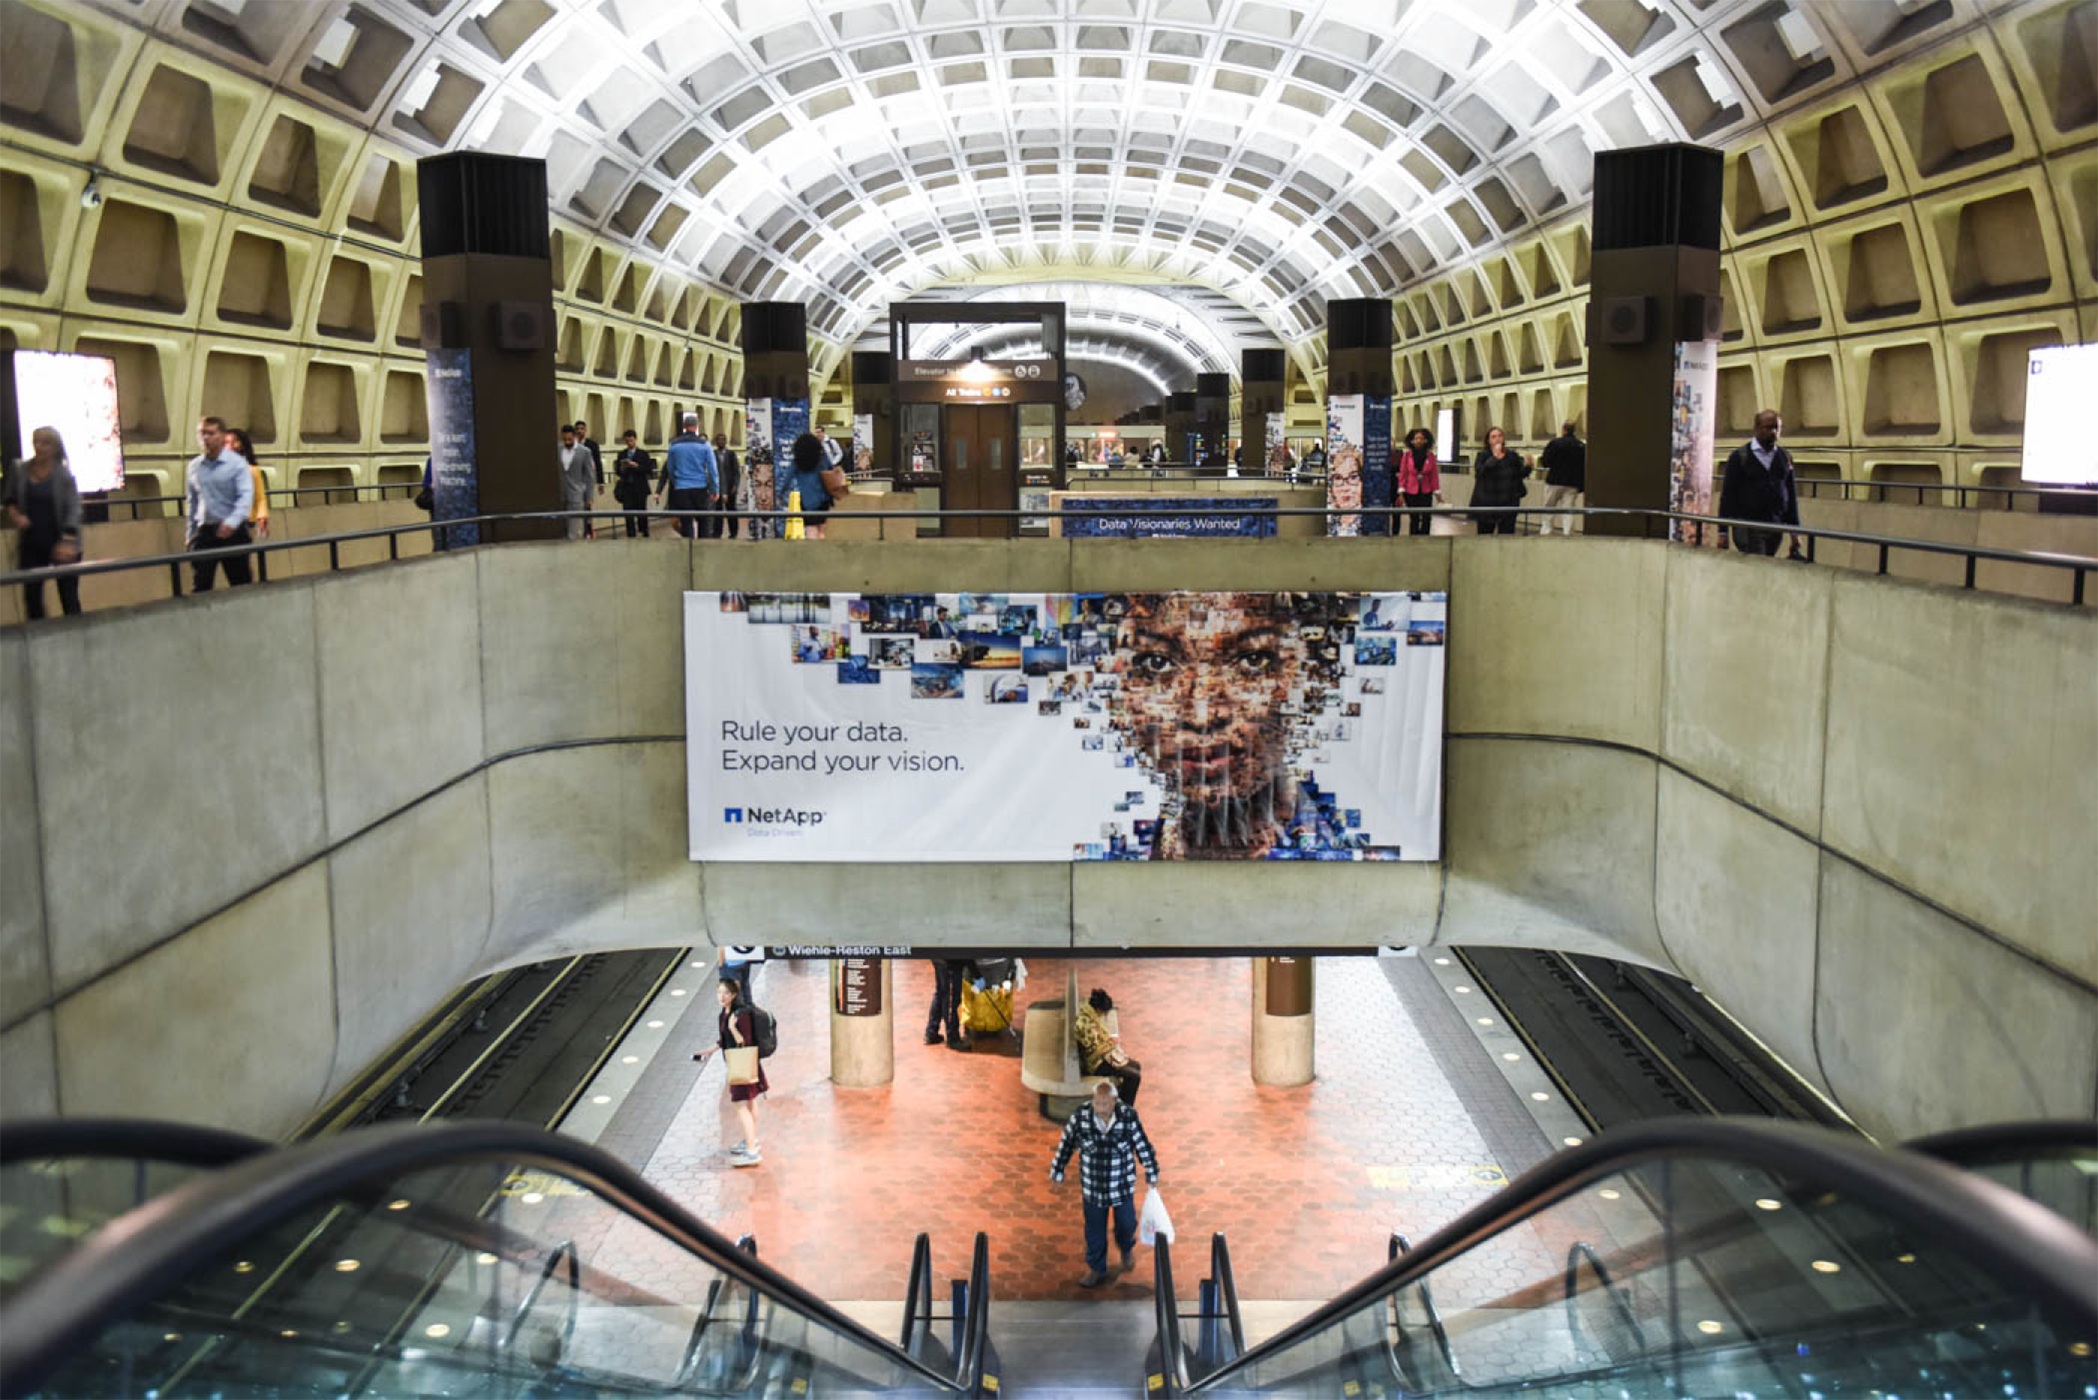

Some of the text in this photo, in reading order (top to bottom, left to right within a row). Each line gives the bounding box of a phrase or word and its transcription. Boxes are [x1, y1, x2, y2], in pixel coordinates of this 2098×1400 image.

[1099, 518, 1240, 530] Data Visionaries Wanted
[721, 720, 908, 747] Rule your data.
[722, 749, 965, 775] Expand your vision.
[747, 807, 823, 827] NetApp
[788, 946, 881, 956] Wiehle-Reston
[884, 946, 911, 956] East
